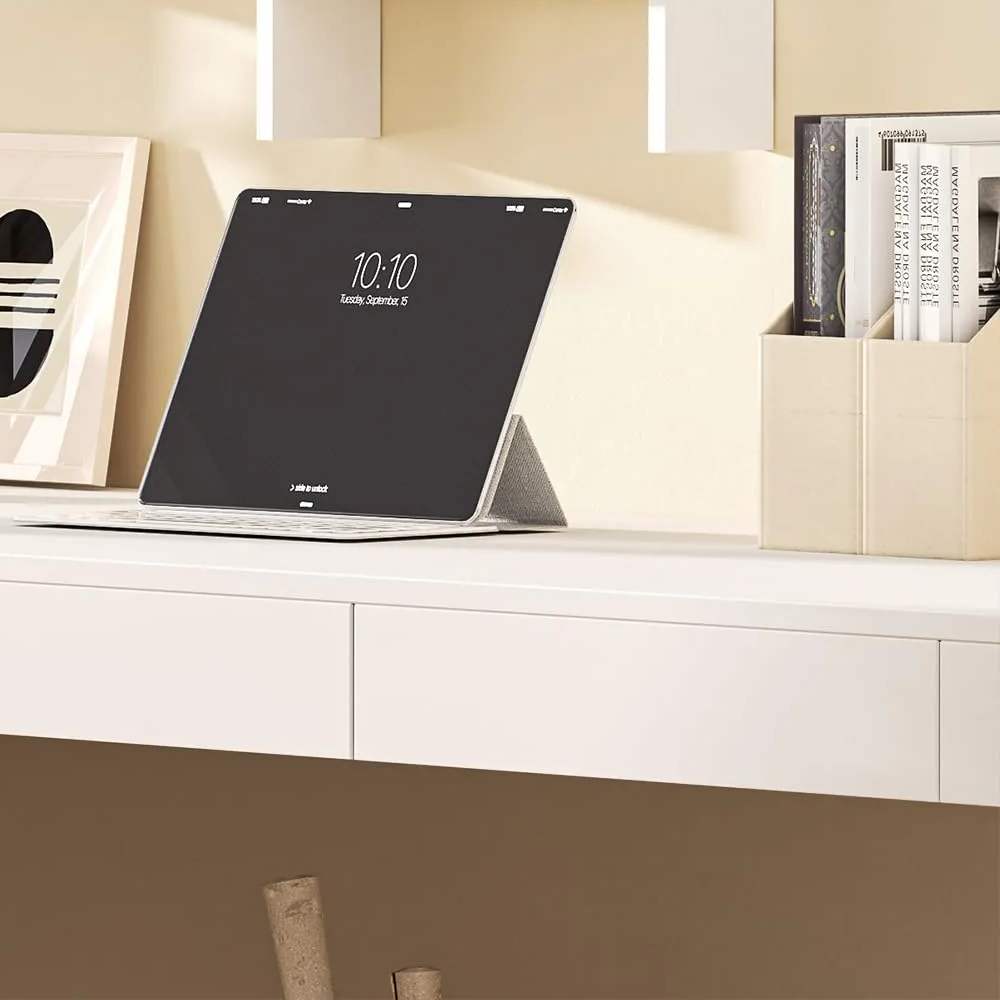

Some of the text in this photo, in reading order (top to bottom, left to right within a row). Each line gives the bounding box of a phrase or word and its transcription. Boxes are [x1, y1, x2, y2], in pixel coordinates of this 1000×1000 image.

[351, 252, 418, 290] 10:10
[340, 294, 365, 306] Tuesday,
[401, 296, 408, 306] 15
